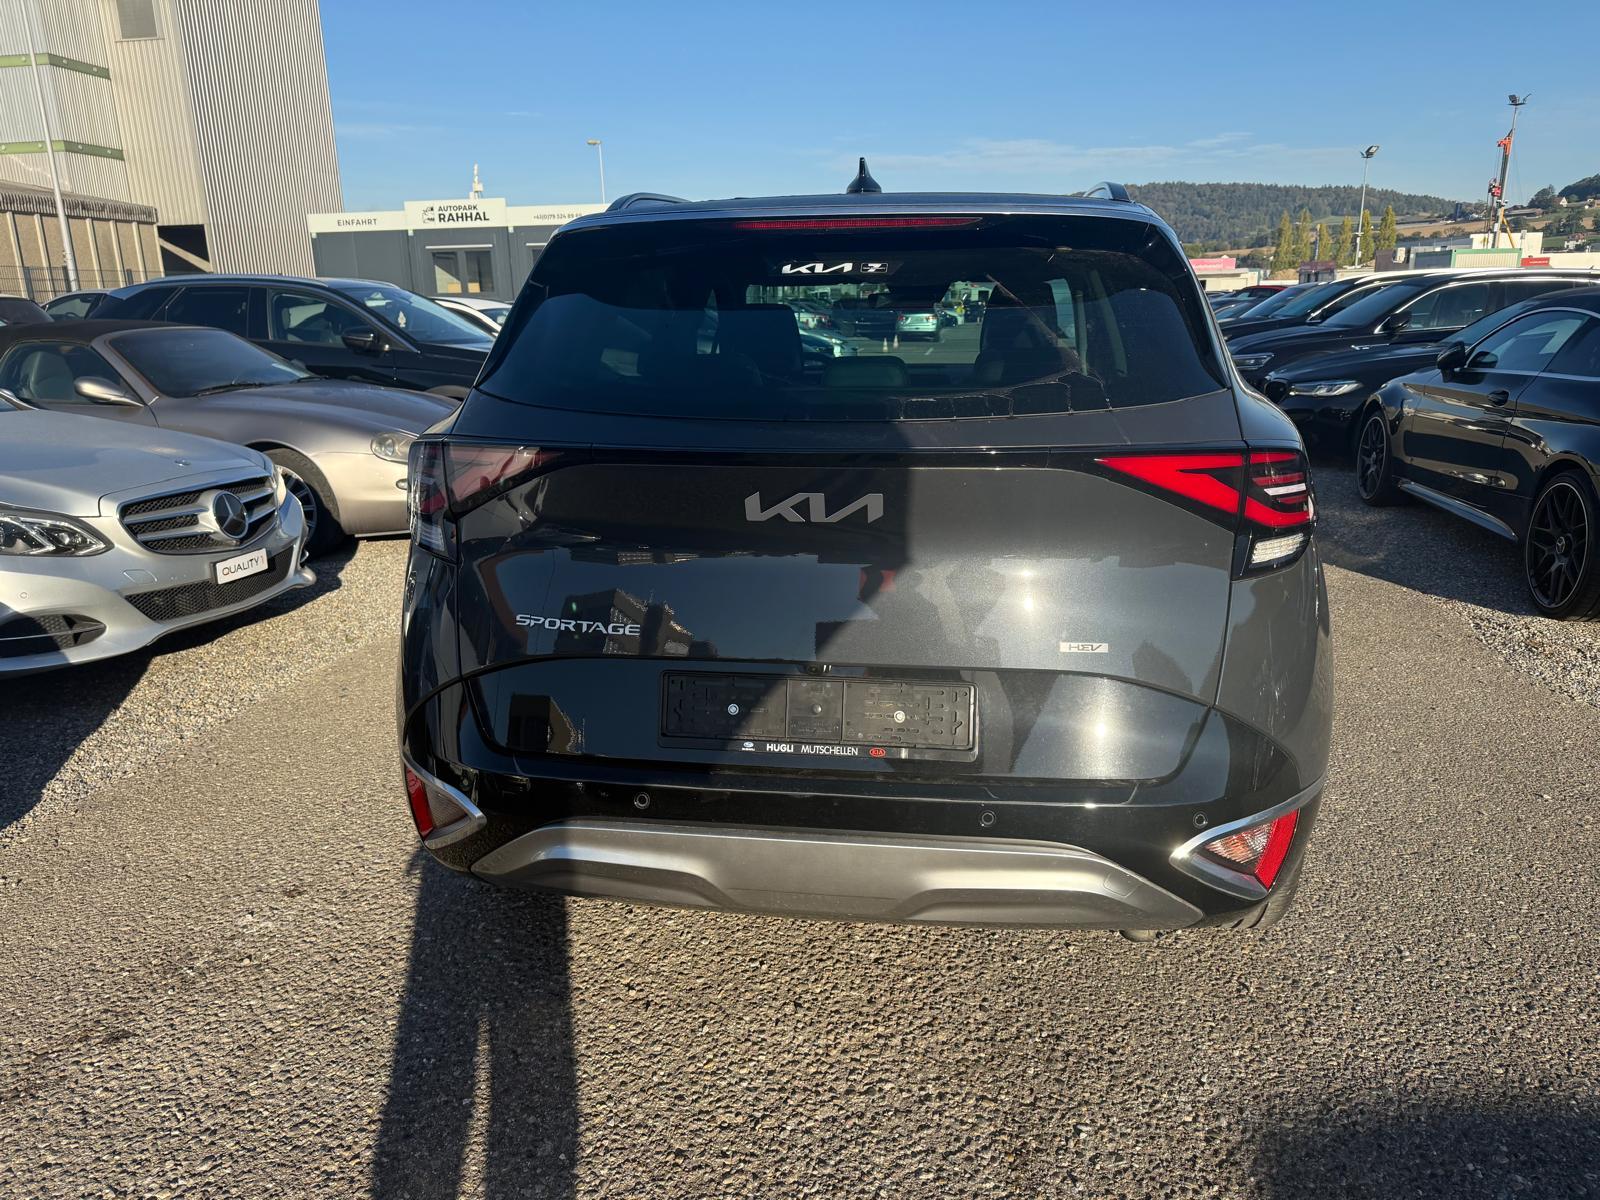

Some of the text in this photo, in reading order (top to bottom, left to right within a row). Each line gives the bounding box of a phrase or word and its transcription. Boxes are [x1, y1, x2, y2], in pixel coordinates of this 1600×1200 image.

[438, 204, 478, 212] AUTOPARK
[337, 218, 377, 226] EINFAHRT
[438, 211, 490, 223] RAHHAL
[782, 262, 854, 274] KIA
[744, 491, 884, 524] KIA
[221, 556, 259, 576] QUALITY
[515, 614, 640, 636] SPORTAGE
[1068, 643, 1103, 652] HEV
[800, 745, 858, 756] MUTSCHELLEN
[870, 748, 885, 757] KIA
